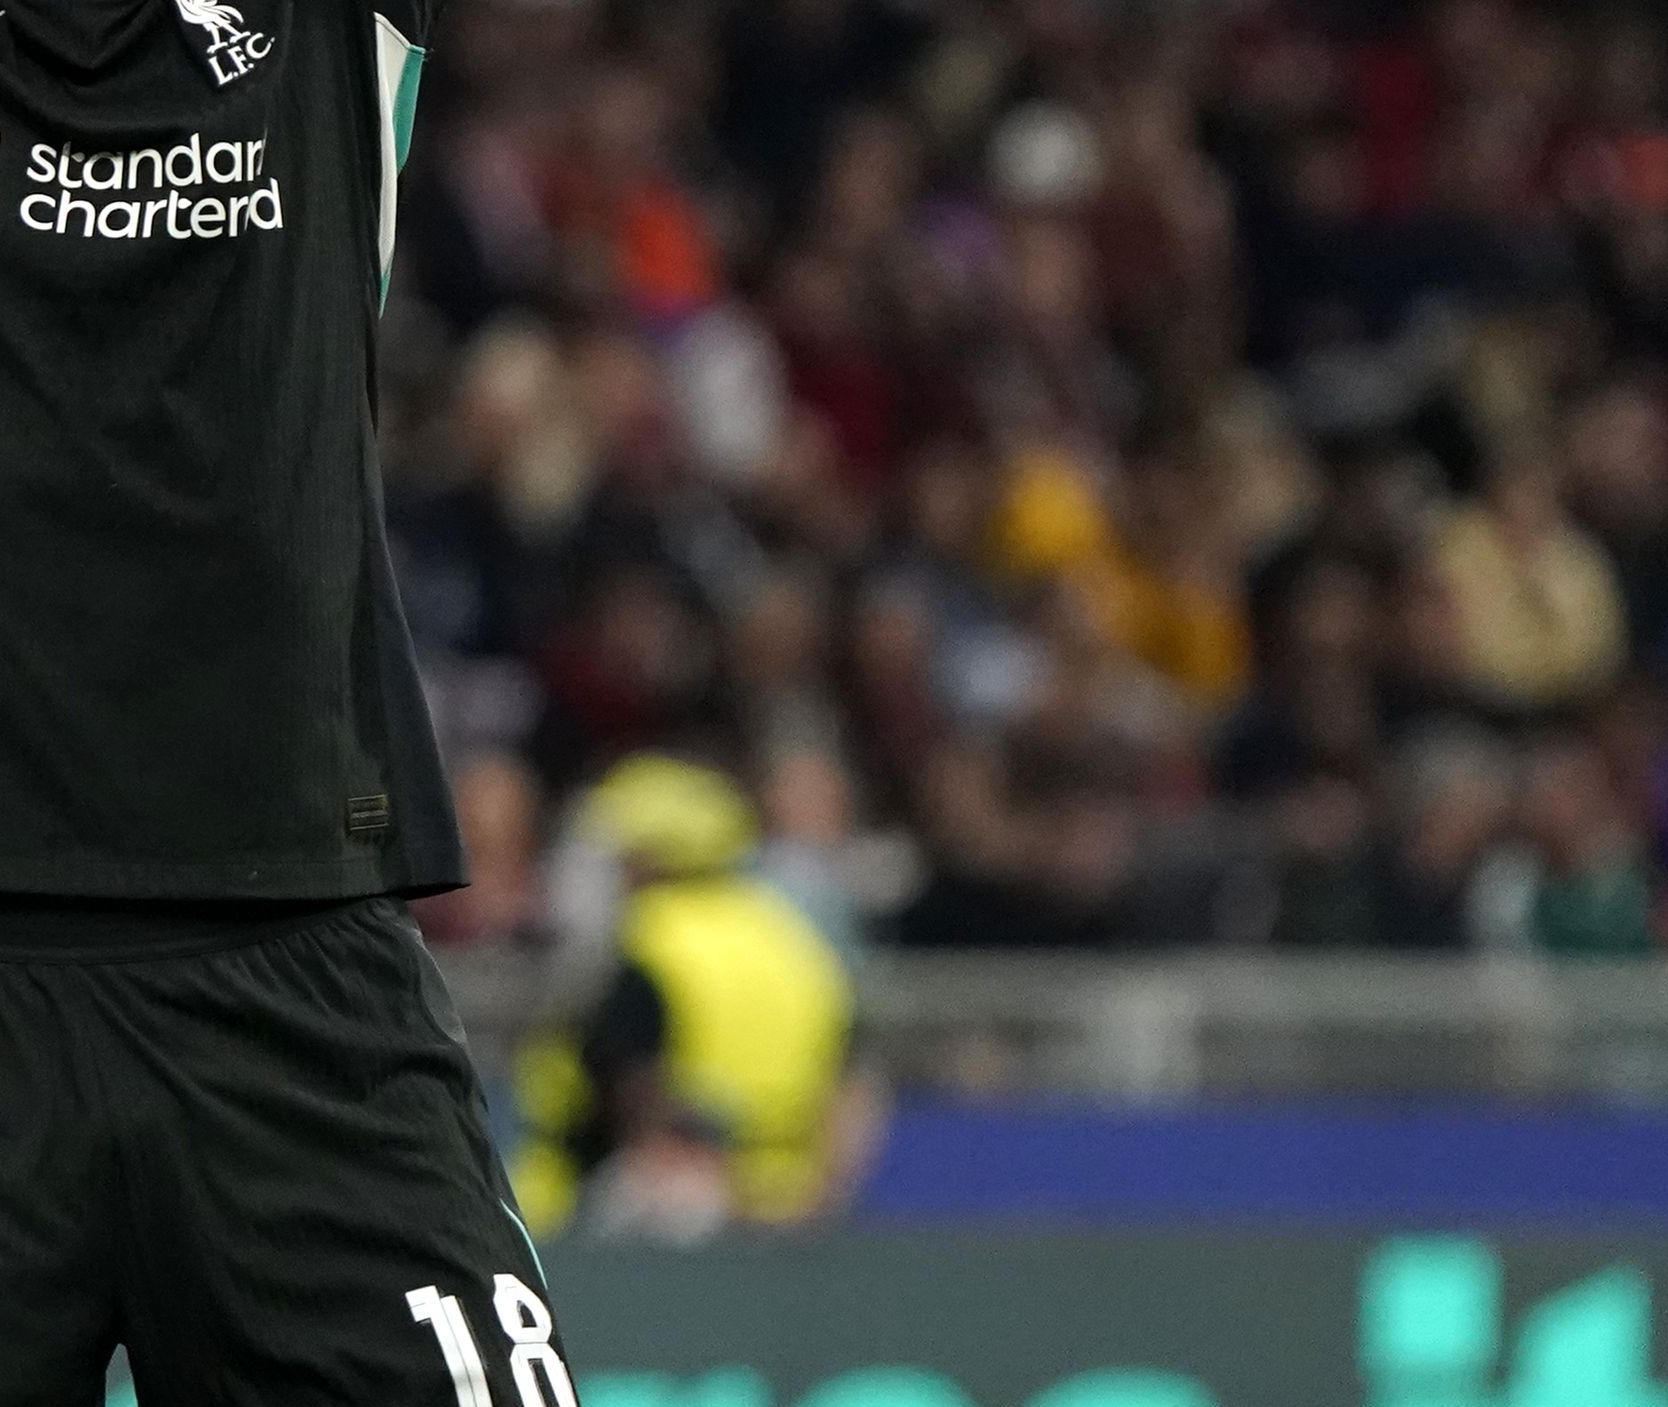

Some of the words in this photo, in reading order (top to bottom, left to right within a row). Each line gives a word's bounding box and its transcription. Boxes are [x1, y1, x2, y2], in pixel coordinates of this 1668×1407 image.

[26, 129, 267, 190] standar
[20, 177, 283, 239] charterd
[405, 1273, 579, 1407] 18
